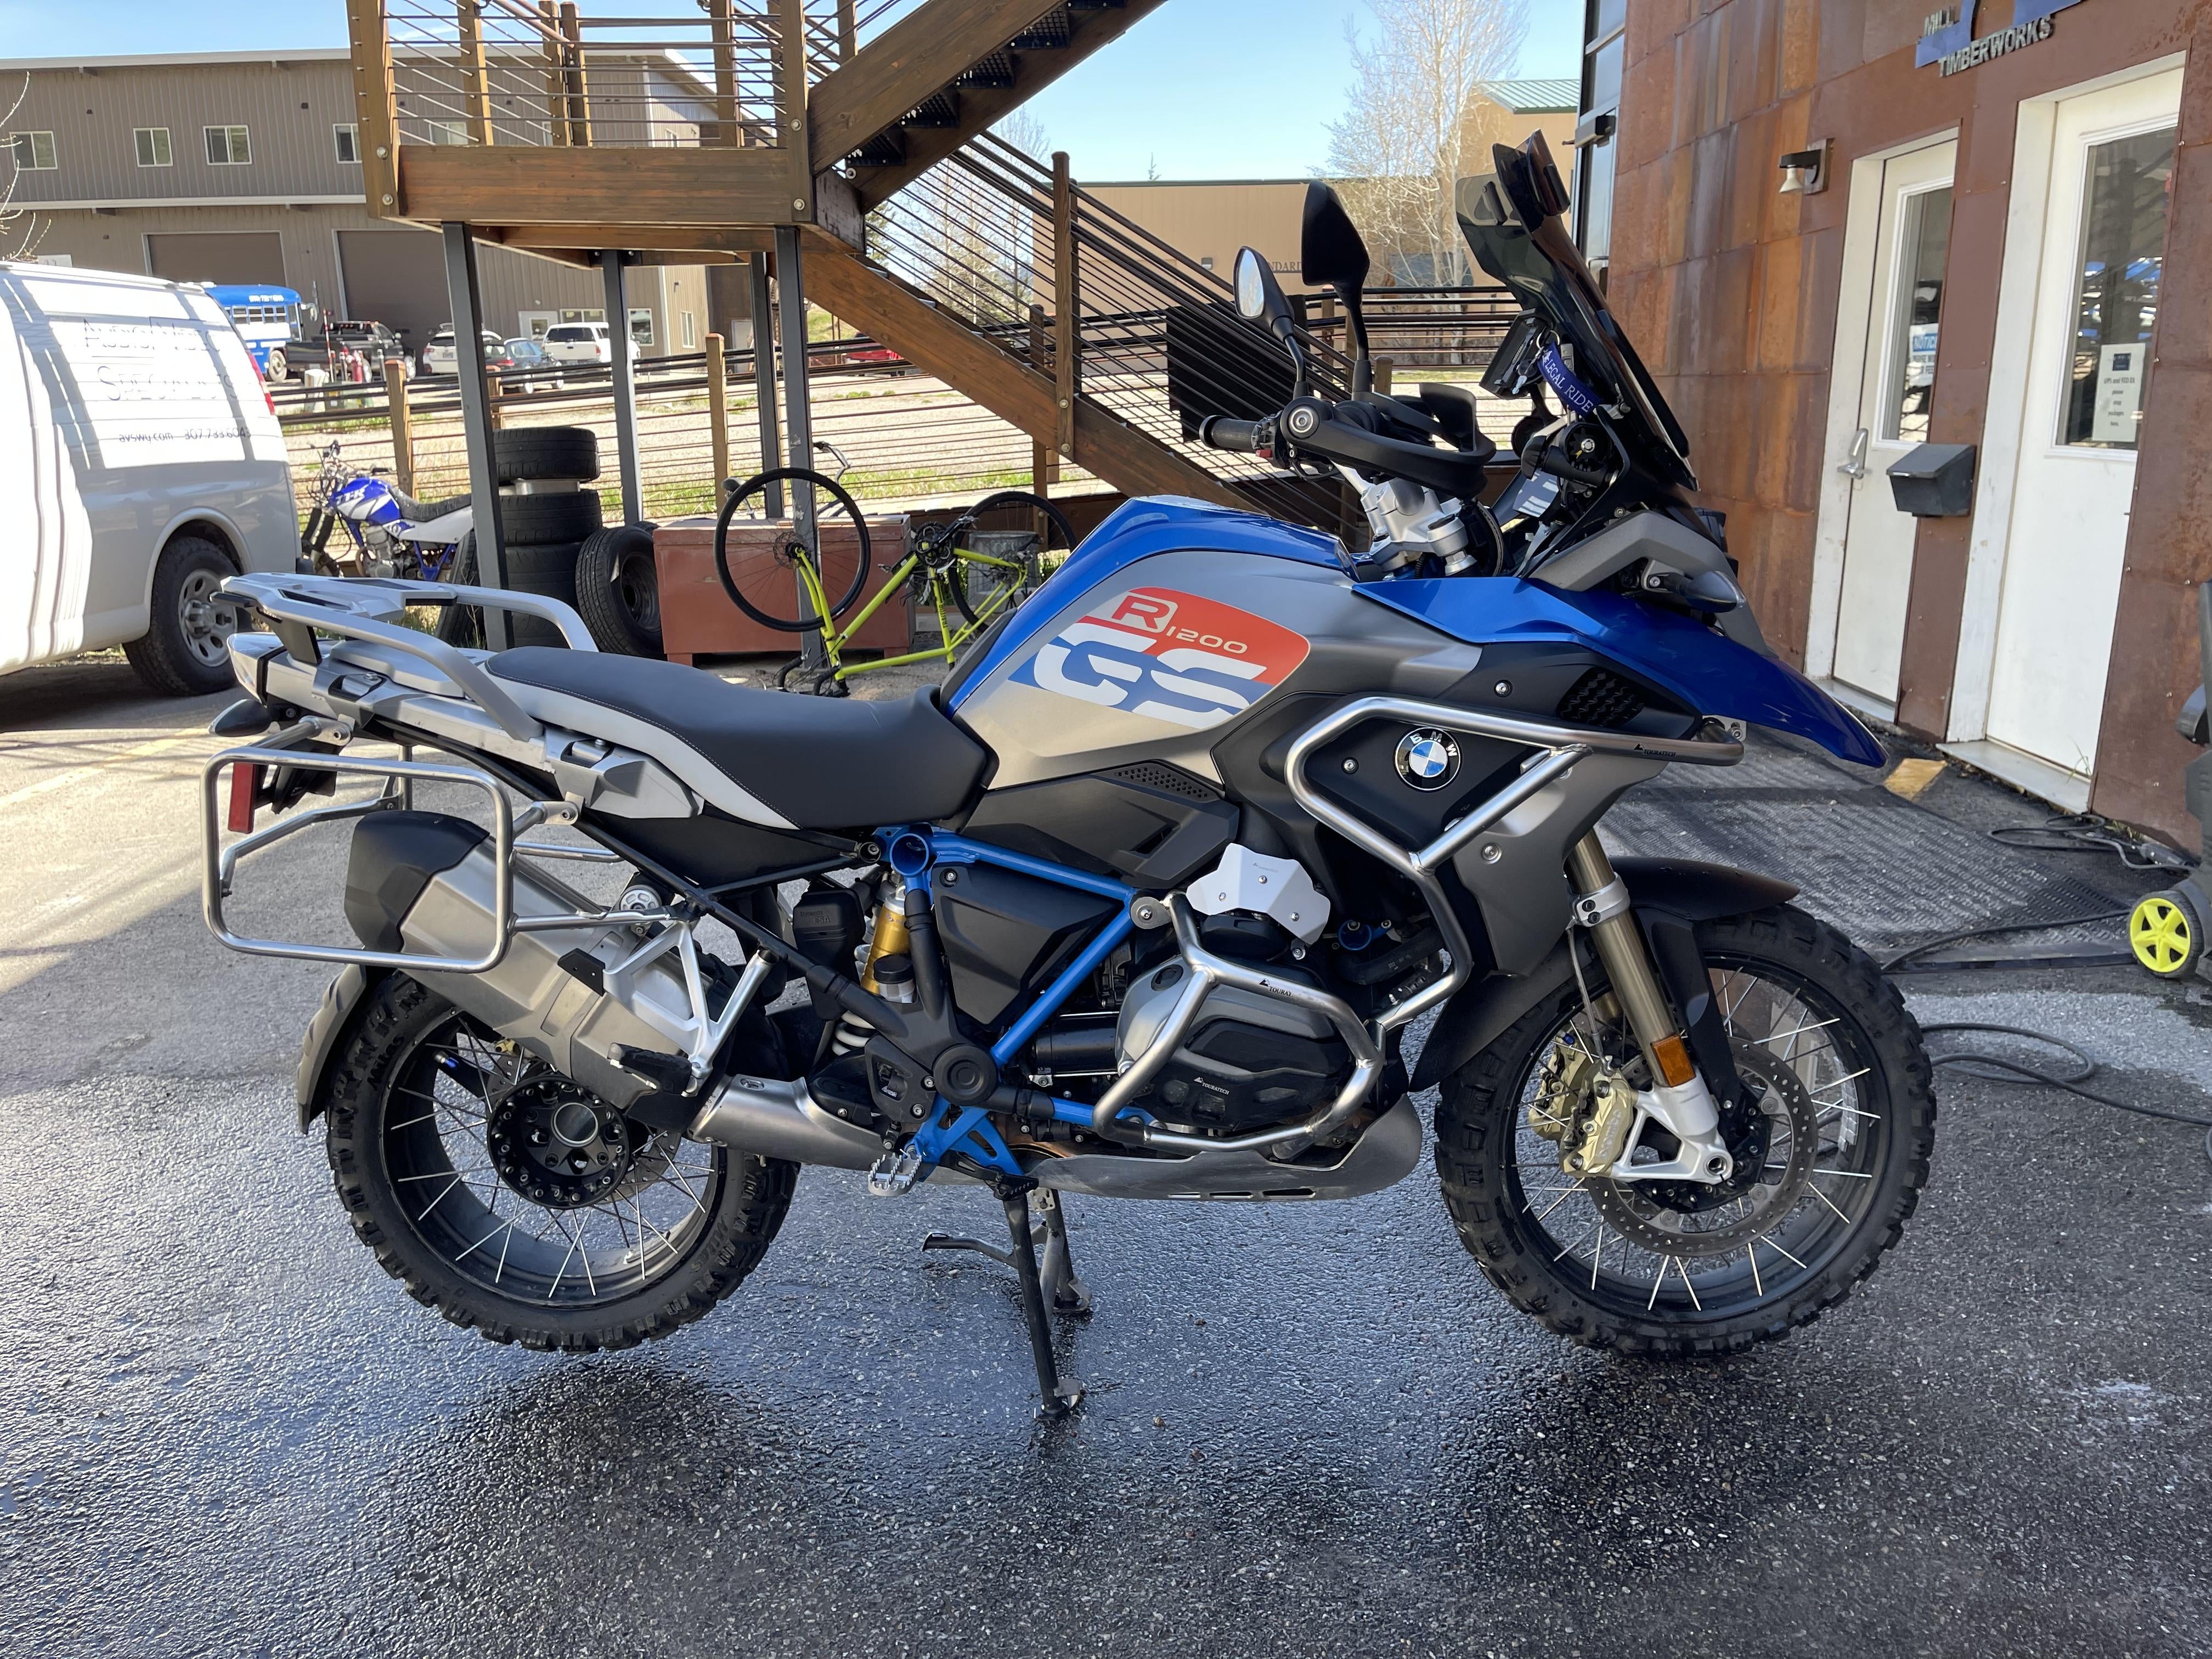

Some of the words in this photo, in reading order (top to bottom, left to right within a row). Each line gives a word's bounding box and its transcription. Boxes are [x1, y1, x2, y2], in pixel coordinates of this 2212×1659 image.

[1923, 9, 1955, 36] MILL
[1938, 17, 2051, 78] TIMBERWORKS
[1544, 359, 1566, 389] LEGAL
[1564, 385, 1594, 413] RIDE
[1166, 625, 1248, 654] 1200
[1034, 622, 1267, 730] GS
[1409, 731, 1458, 757] BMW
[1644, 749, 1677, 758] TOURATECH
[813, 915, 830, 924] ESA
[1202, 1082, 1230, 1096] TOURATECH
